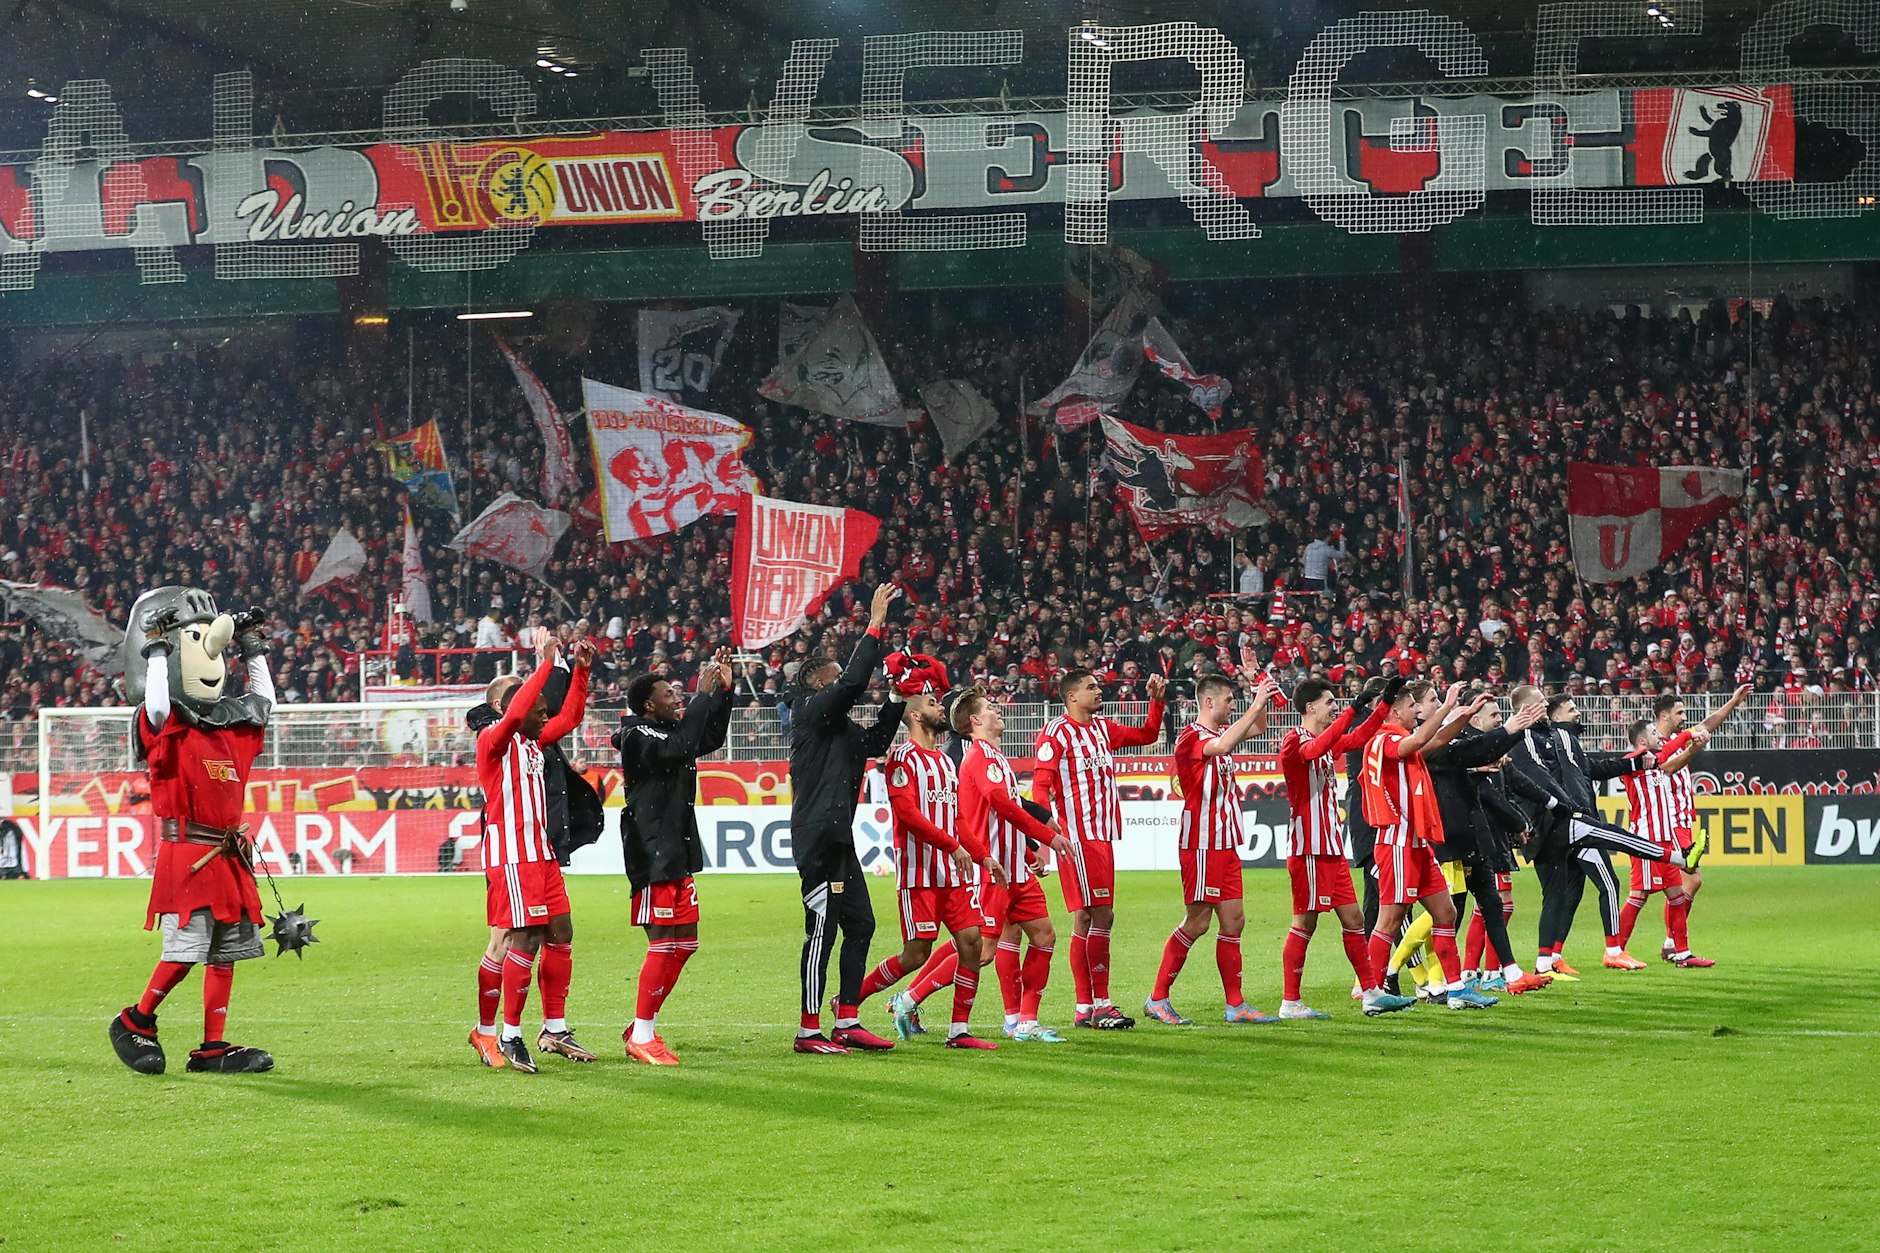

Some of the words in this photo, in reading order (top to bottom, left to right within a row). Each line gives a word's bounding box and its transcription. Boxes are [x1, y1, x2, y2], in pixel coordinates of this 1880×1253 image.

[236, 189, 421, 241] Union
[693, 168, 889, 222] Berlin
[554, 159, 674, 213] UNION
